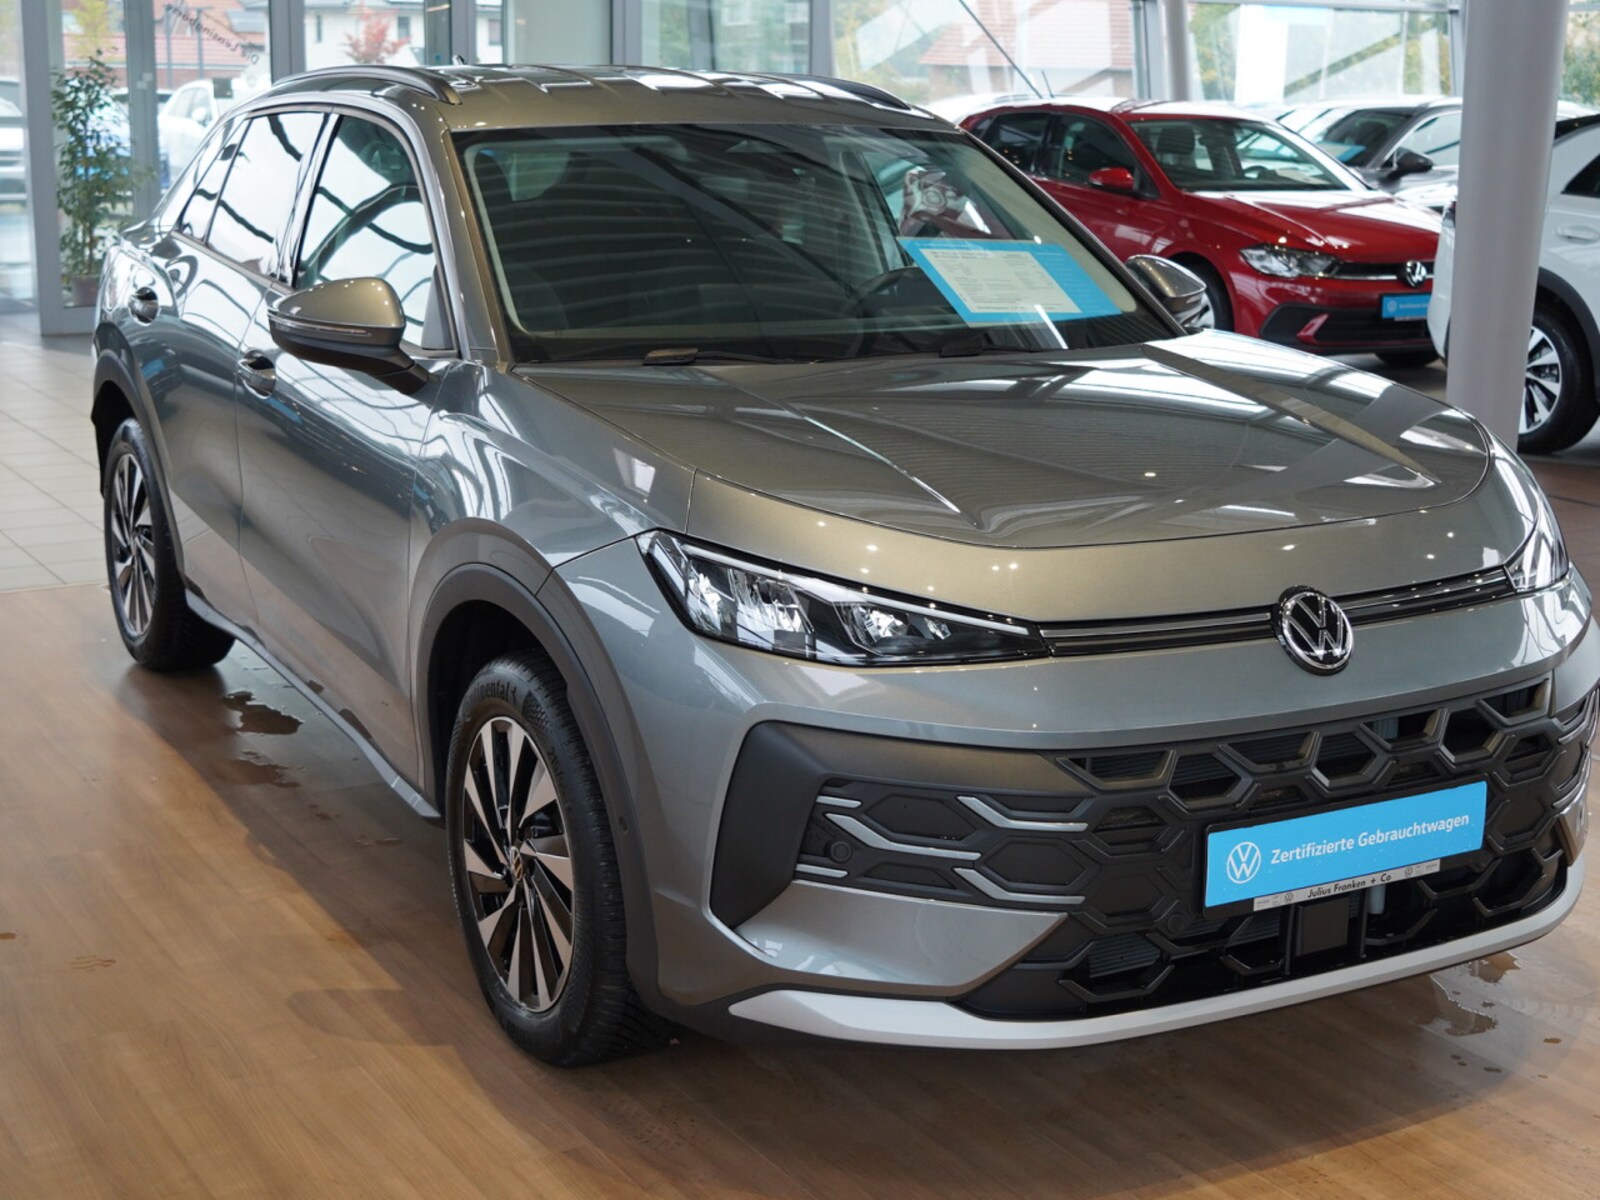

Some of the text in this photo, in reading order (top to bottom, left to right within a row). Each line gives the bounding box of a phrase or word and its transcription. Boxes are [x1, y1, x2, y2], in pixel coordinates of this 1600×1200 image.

[1282, 591, 1354, 669] VW
[1226, 841, 1262, 884] VW
[1271, 813, 1470, 865] Zertifizierte Gebrauchtwagen
[1307, 881, 1332, 899] Julius
[1333, 879, 1367, 893] Franken
[1380, 873, 1392, 883] Co
